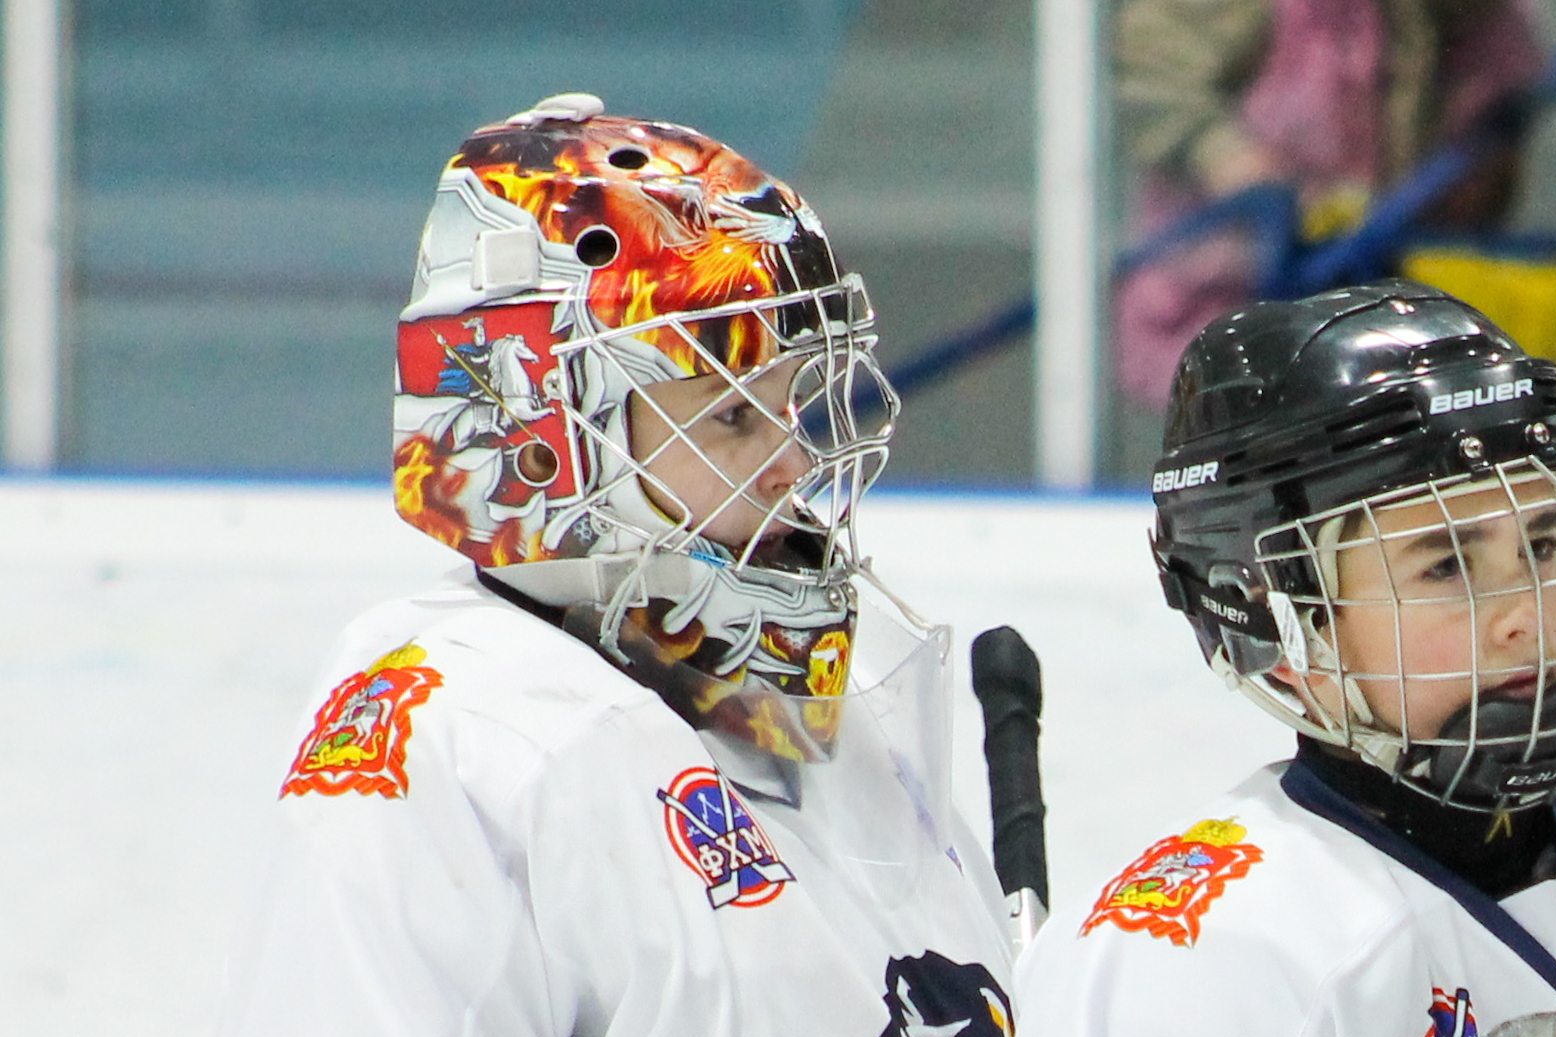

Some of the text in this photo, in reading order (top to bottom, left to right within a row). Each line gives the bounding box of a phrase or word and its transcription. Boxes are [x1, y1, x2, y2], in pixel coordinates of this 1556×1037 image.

[1430, 378, 1534, 415] BAUER
[1153, 461, 1219, 494] BAUER
[1201, 594, 1249, 625] BAUER
[698, 825, 772, 878] ФХМ
